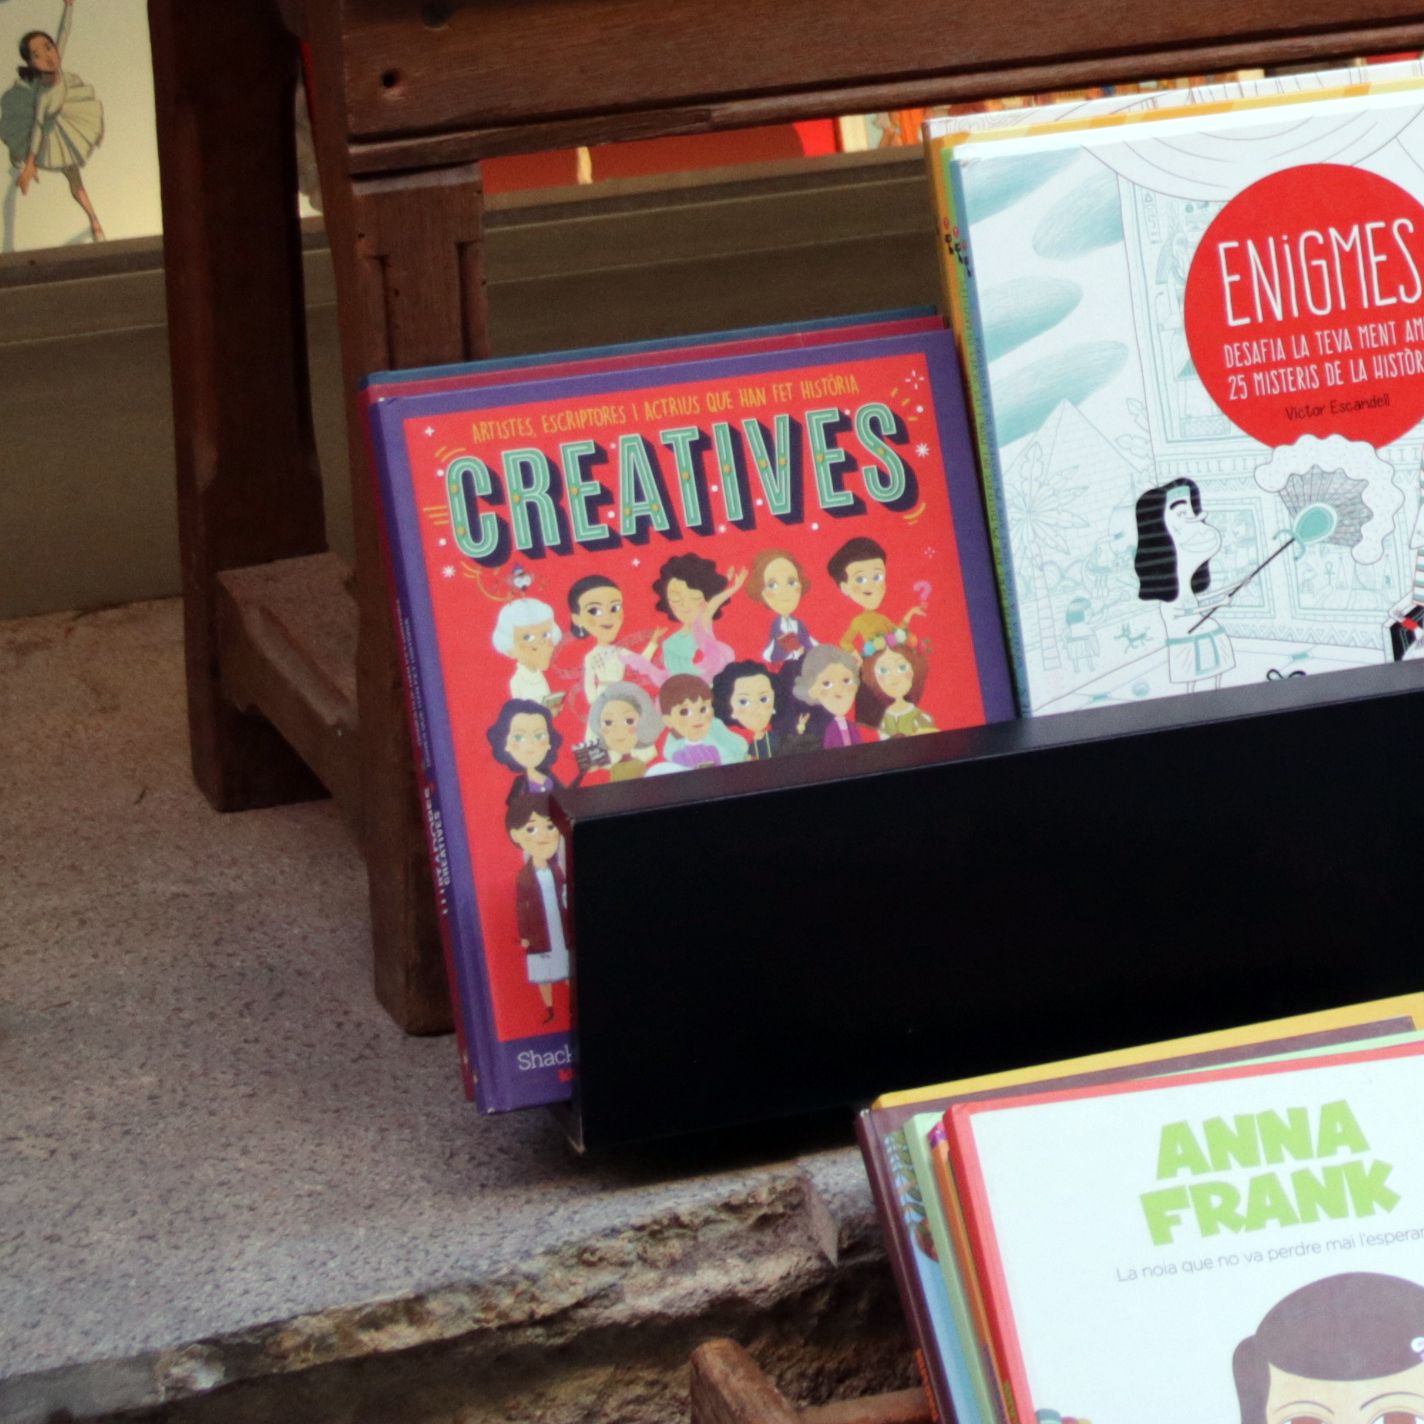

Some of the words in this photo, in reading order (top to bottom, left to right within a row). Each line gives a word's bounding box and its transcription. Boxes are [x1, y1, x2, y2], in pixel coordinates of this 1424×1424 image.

[1223, 337, 1288, 368] DESAFIA
[1291, 333, 1311, 359] LA
[1315, 328, 1354, 356] TEVA
[1358, 323, 1400, 351] MENT
[471, 416, 540, 442] ARTISTES,
[541, 405, 626, 433] ESCRIPTORES
[630, 404, 640, 419] I
[643, 397, 701, 421] ACTRIUS
[705, 391, 734, 413] QUE
[738, 386, 766, 409] HAN
[771, 381, 794, 403] FET
[800, 373, 860, 399] HISTÒRIA
[1228, 375, 1249, 401] 25
[1253, 363, 1320, 397] MISTERIS
[1325, 361, 1345, 387] DE
[1348, 359, 1369, 384] LA
[1330, 392, 1391, 416] Escandell
[444, 402, 916, 560] CREATIVES
[1156, 1100, 1371, 1180] ANNA
[1140, 1157, 1401, 1246] FRANK
[1116, 1266, 1140, 1284] La
[1143, 1262, 1178, 1280] noia
[1182, 1258, 1214, 1278] que
[1217, 1254, 1239, 1269] no
[1242, 1251, 1262, 1266] va
[1267, 1240, 1321, 1266] perdre
[1326, 1235, 1356, 1251] mai
